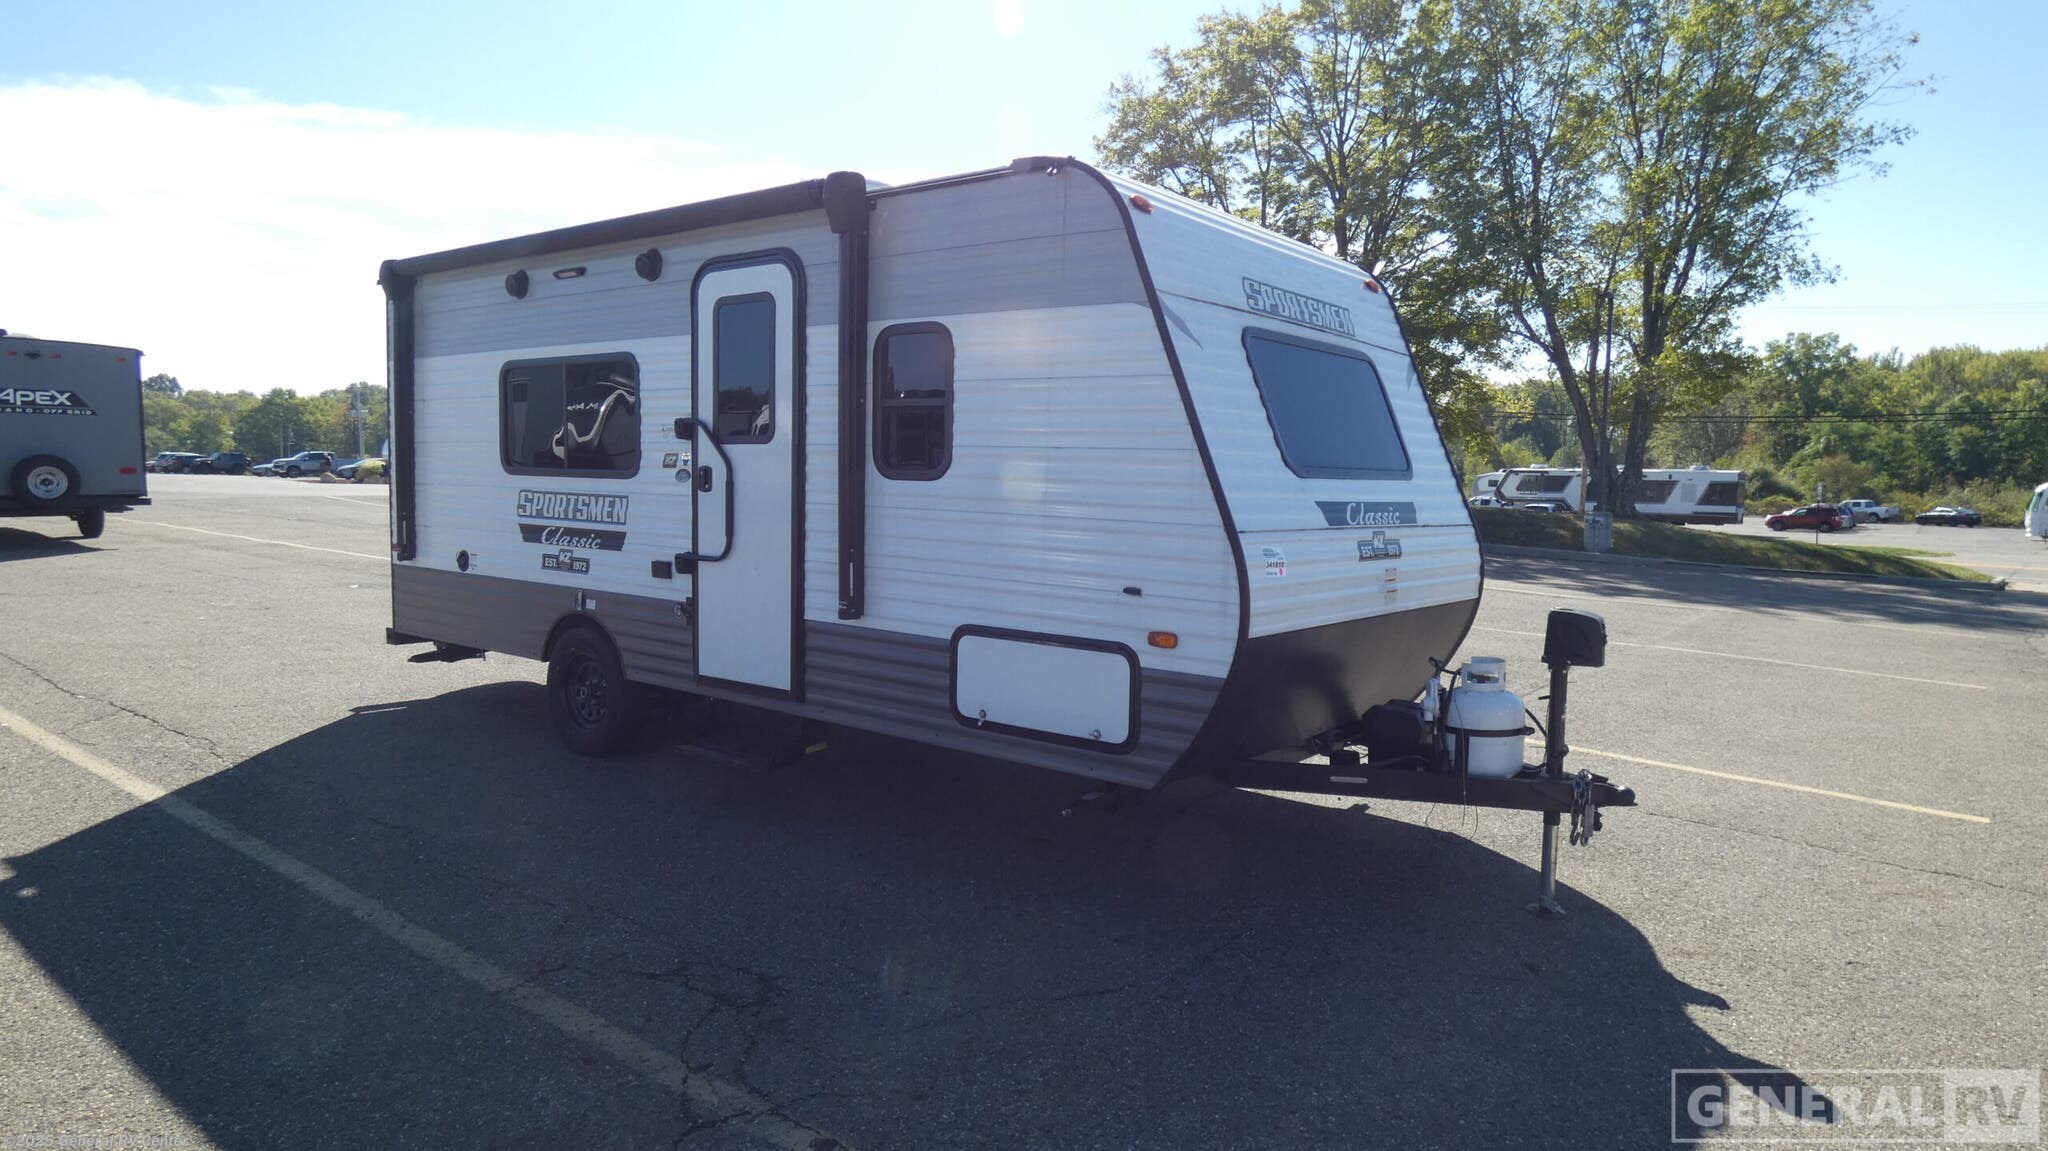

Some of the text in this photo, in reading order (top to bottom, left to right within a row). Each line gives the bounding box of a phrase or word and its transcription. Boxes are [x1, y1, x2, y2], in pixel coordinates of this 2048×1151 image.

[1242, 278, 1356, 336] SPORTSMEN
[0, 388, 72, 405] APEX
[518, 491, 627, 524] SPORTSMEN
[1346, 503, 1400, 525] Classic
[541, 526, 601, 549] Classic
[573, 561, 587, 571] 1972
